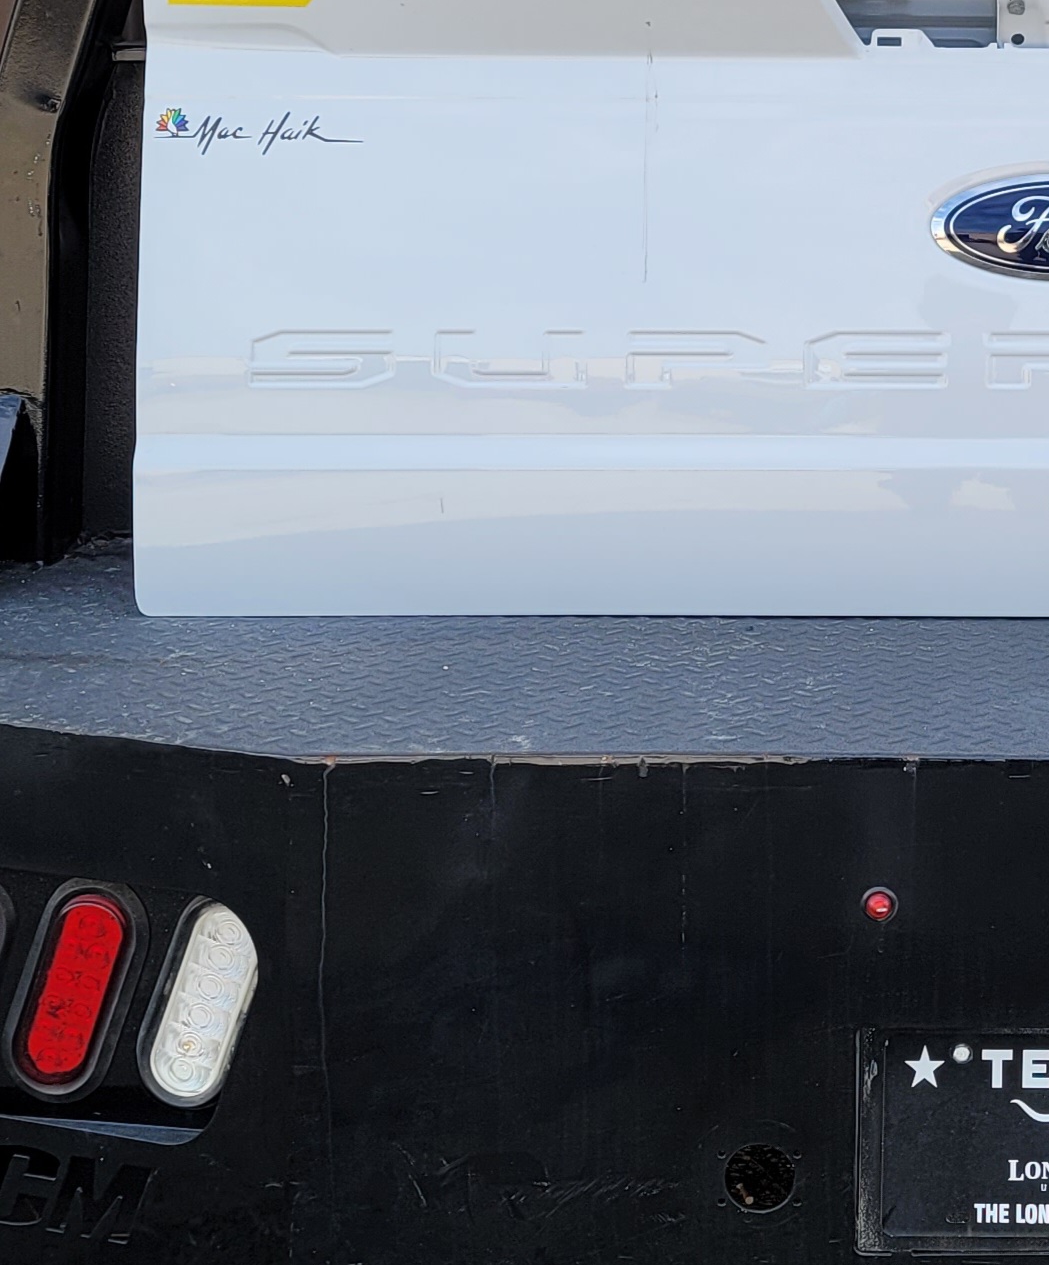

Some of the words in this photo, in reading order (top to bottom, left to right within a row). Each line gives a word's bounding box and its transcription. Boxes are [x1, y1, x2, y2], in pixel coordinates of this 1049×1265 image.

[194, 114, 252, 156] Mac
[256, 111, 364, 156] Haik
[974, 1203, 1010, 1224] THE
